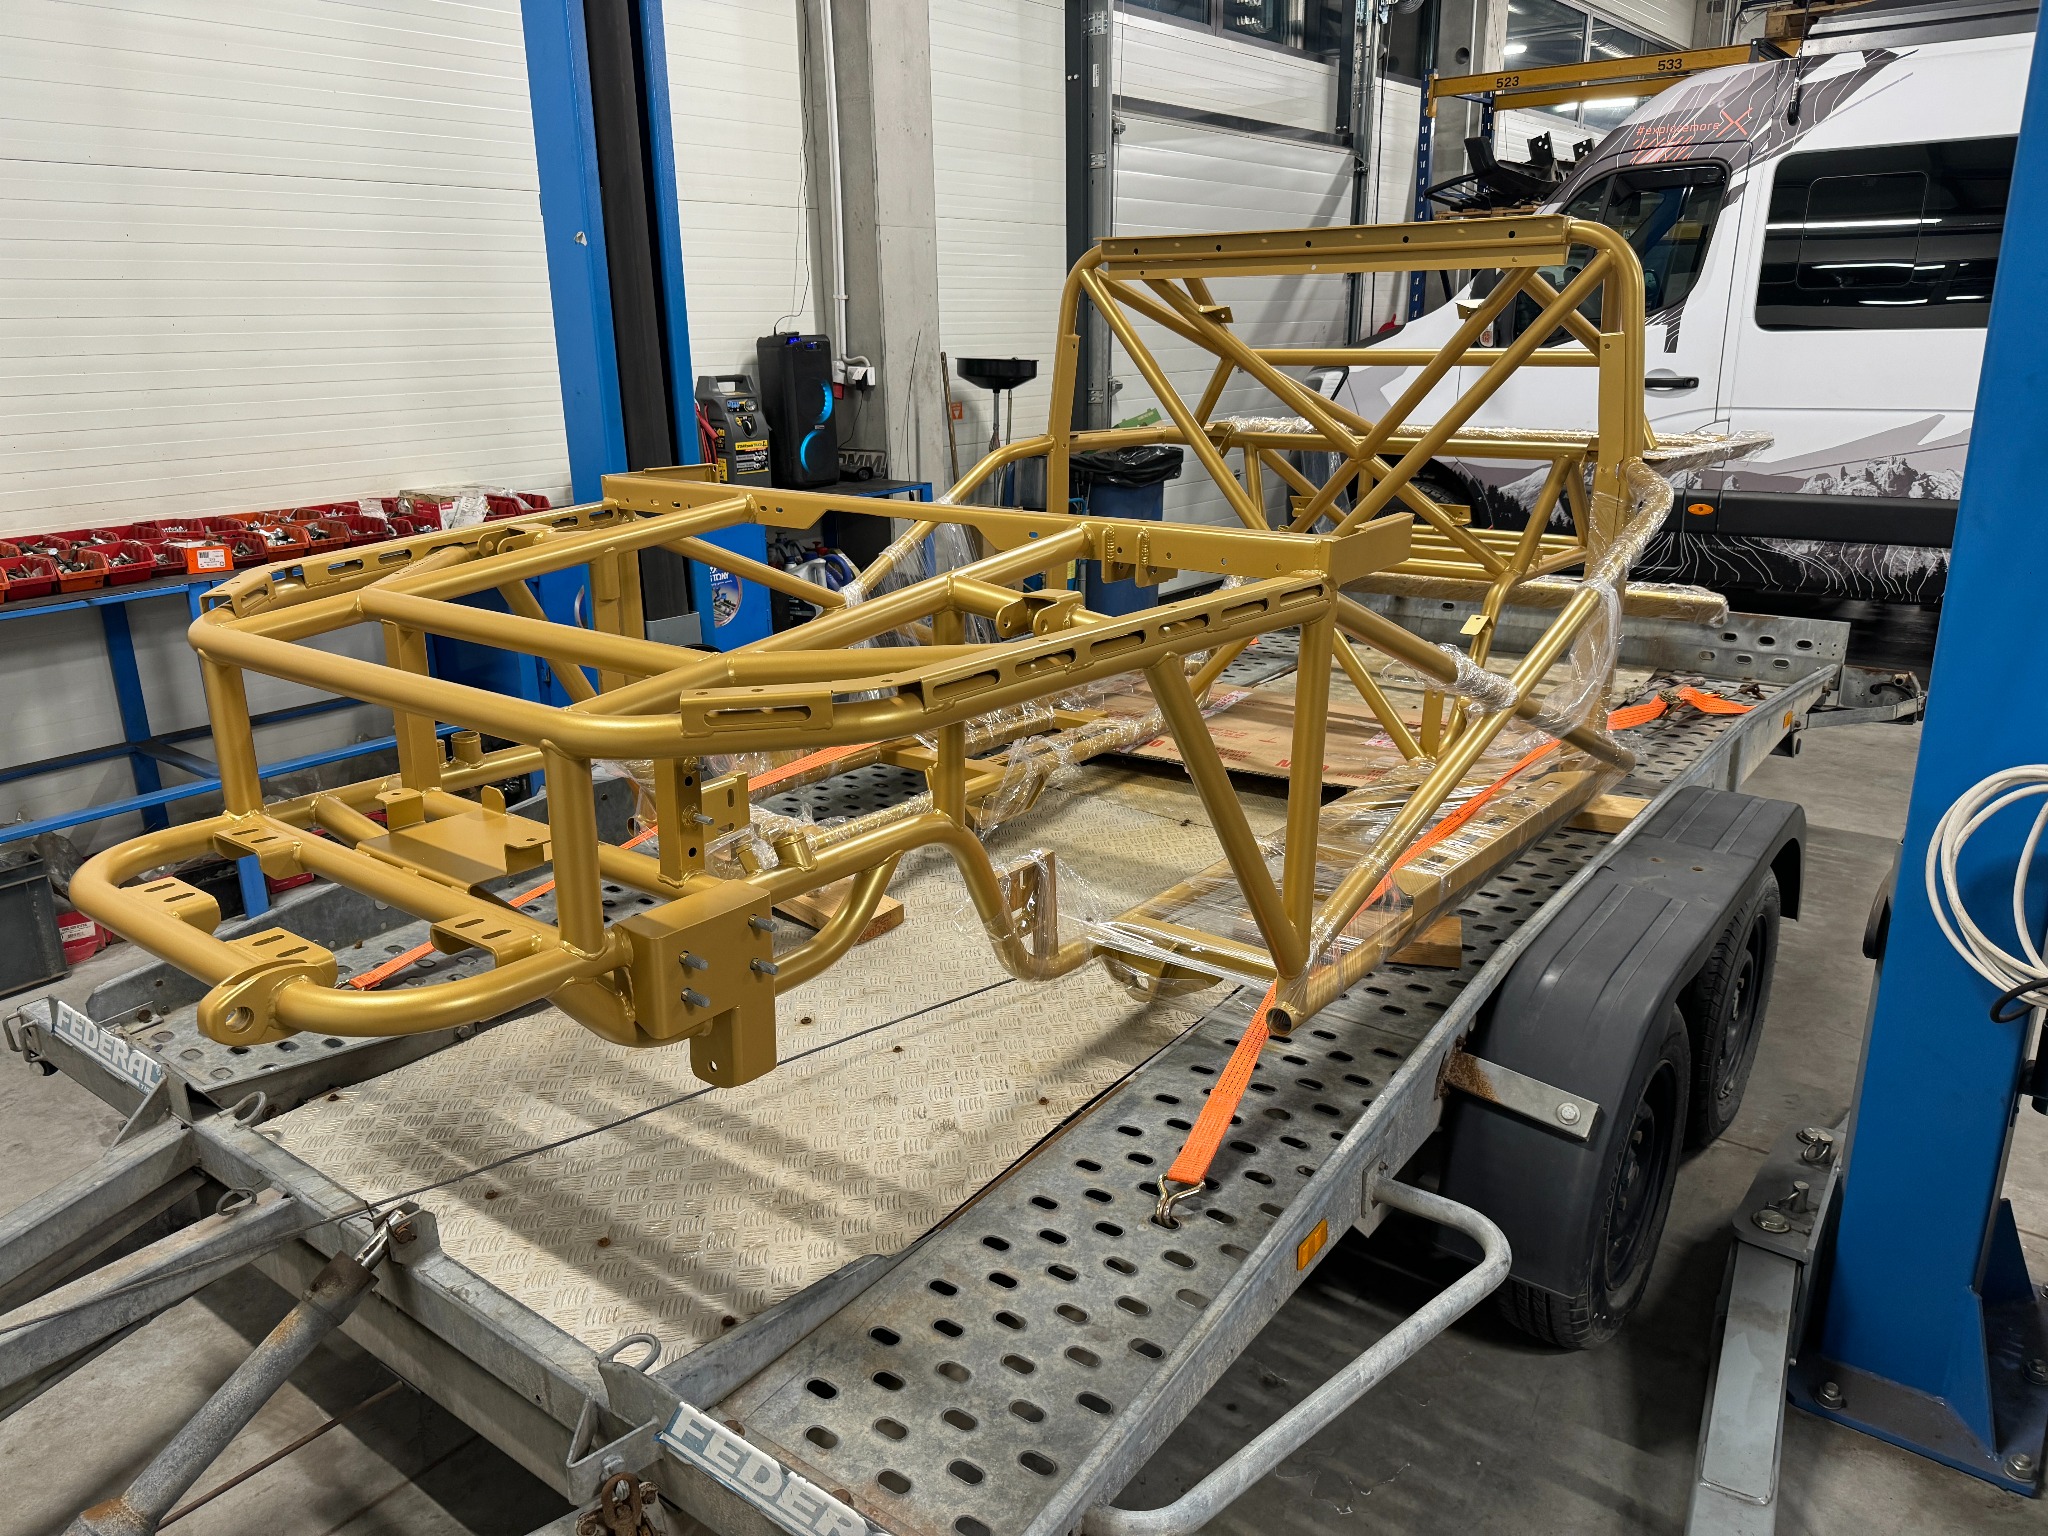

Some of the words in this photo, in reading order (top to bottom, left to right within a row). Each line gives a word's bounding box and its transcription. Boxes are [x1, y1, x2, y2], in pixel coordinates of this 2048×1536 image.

[1657, 58, 1682, 71] 533
[1496, 76, 1519, 88] 523
[1636, 121, 1721, 136] #exploremore
[56, 1001, 158, 1089] FEDERAL
[670, 1401, 891, 1536] FEDER
